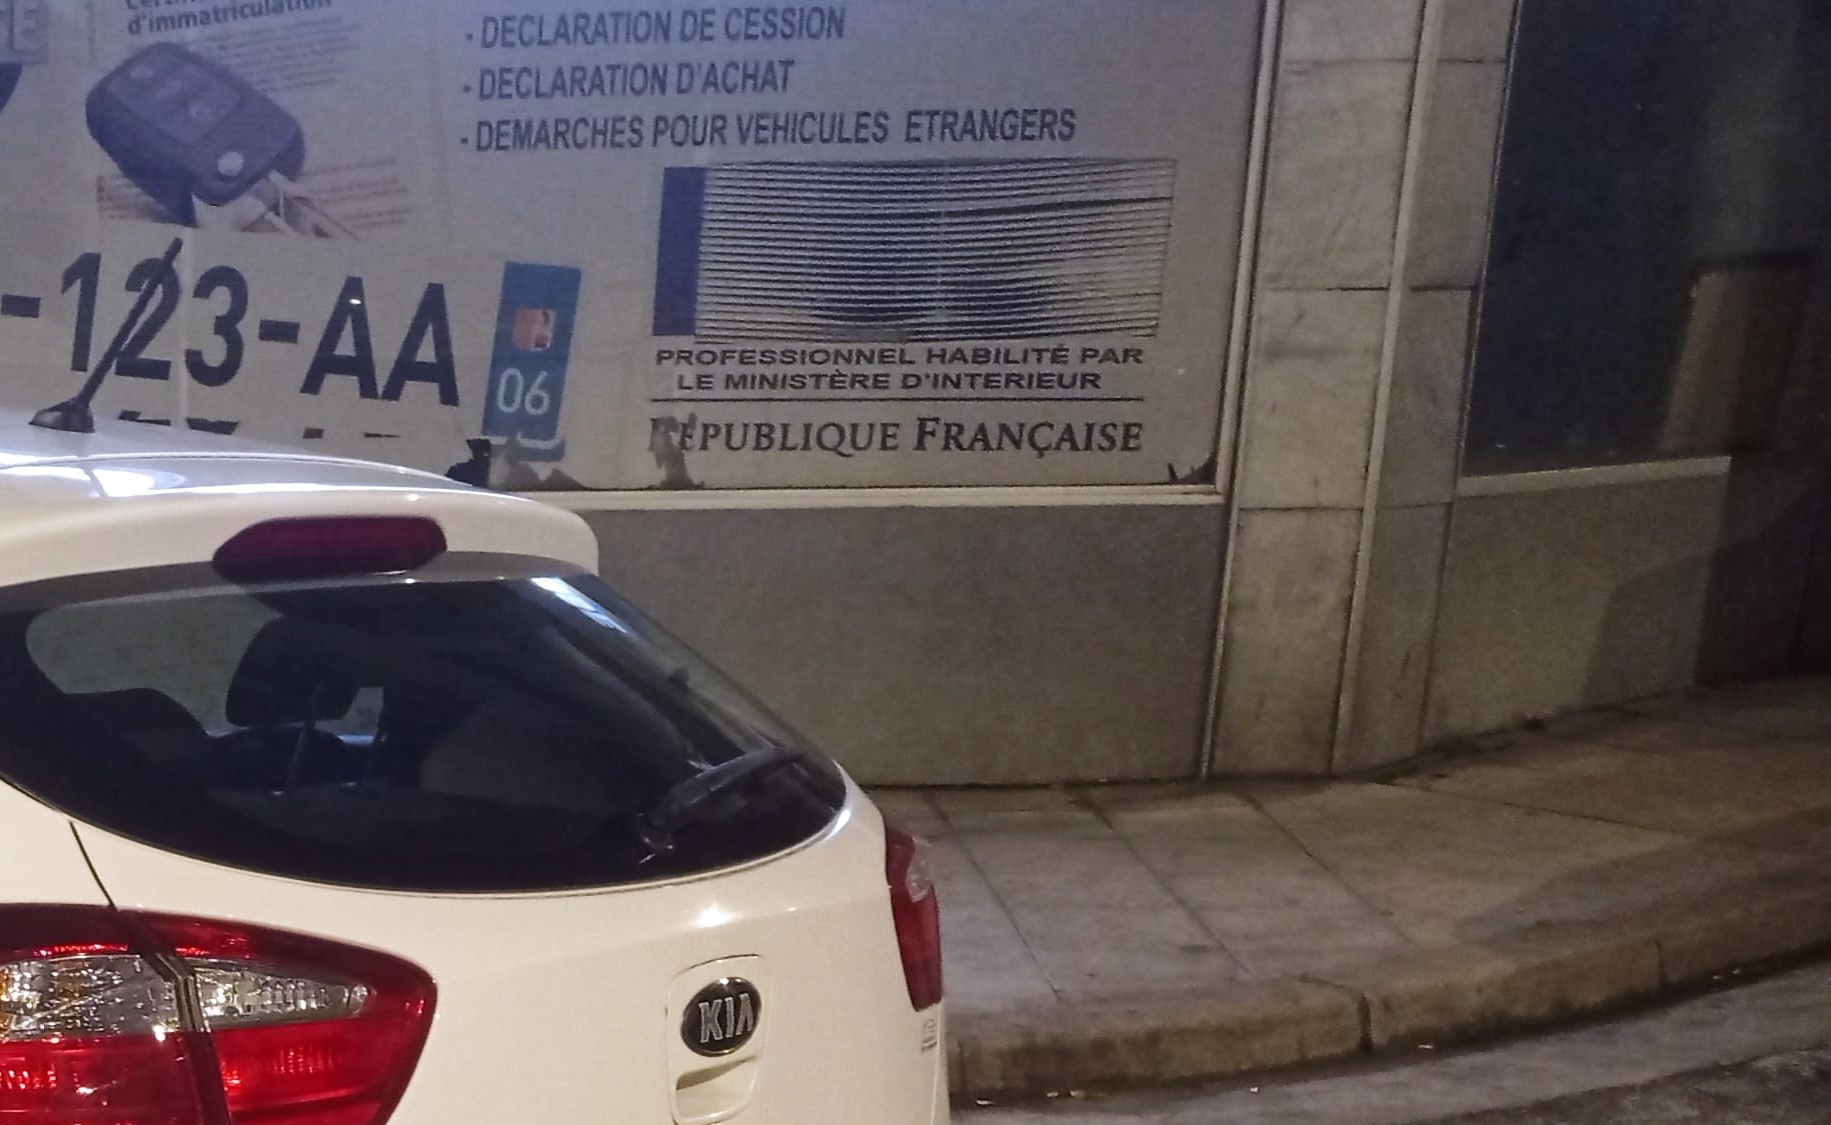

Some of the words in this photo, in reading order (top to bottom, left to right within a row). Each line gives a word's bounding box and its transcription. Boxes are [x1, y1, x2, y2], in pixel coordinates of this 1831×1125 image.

[481, 10, 670, 48] DECLARATION
[679, 8, 716, 42] DE
[725, 6, 846, 41] CESSION
[479, 62, 668, 100] DECLARATION
[676, 59, 795, 95] D'ACHAT
[475, 115, 644, 151] DEMARCHES
[653, 113, 727, 147] POUR
[736, 111, 890, 145] VEHICULES
[905, 108, 1077, 143] ETRANGERS
[656, 348, 915, 366] PROFESSIONNEL
[926, 344, 1070, 365] HABILITÉ
[1080, 348, 1143, 364] PAR
[497, 368, 551, 416] 06
[677, 373, 714, 390] LE
[724, 369, 890, 390] MINISTÈRE
[901, 372, 1101, 390] D'INTERIEUR
[698, 993, 754, 1043] KIA
